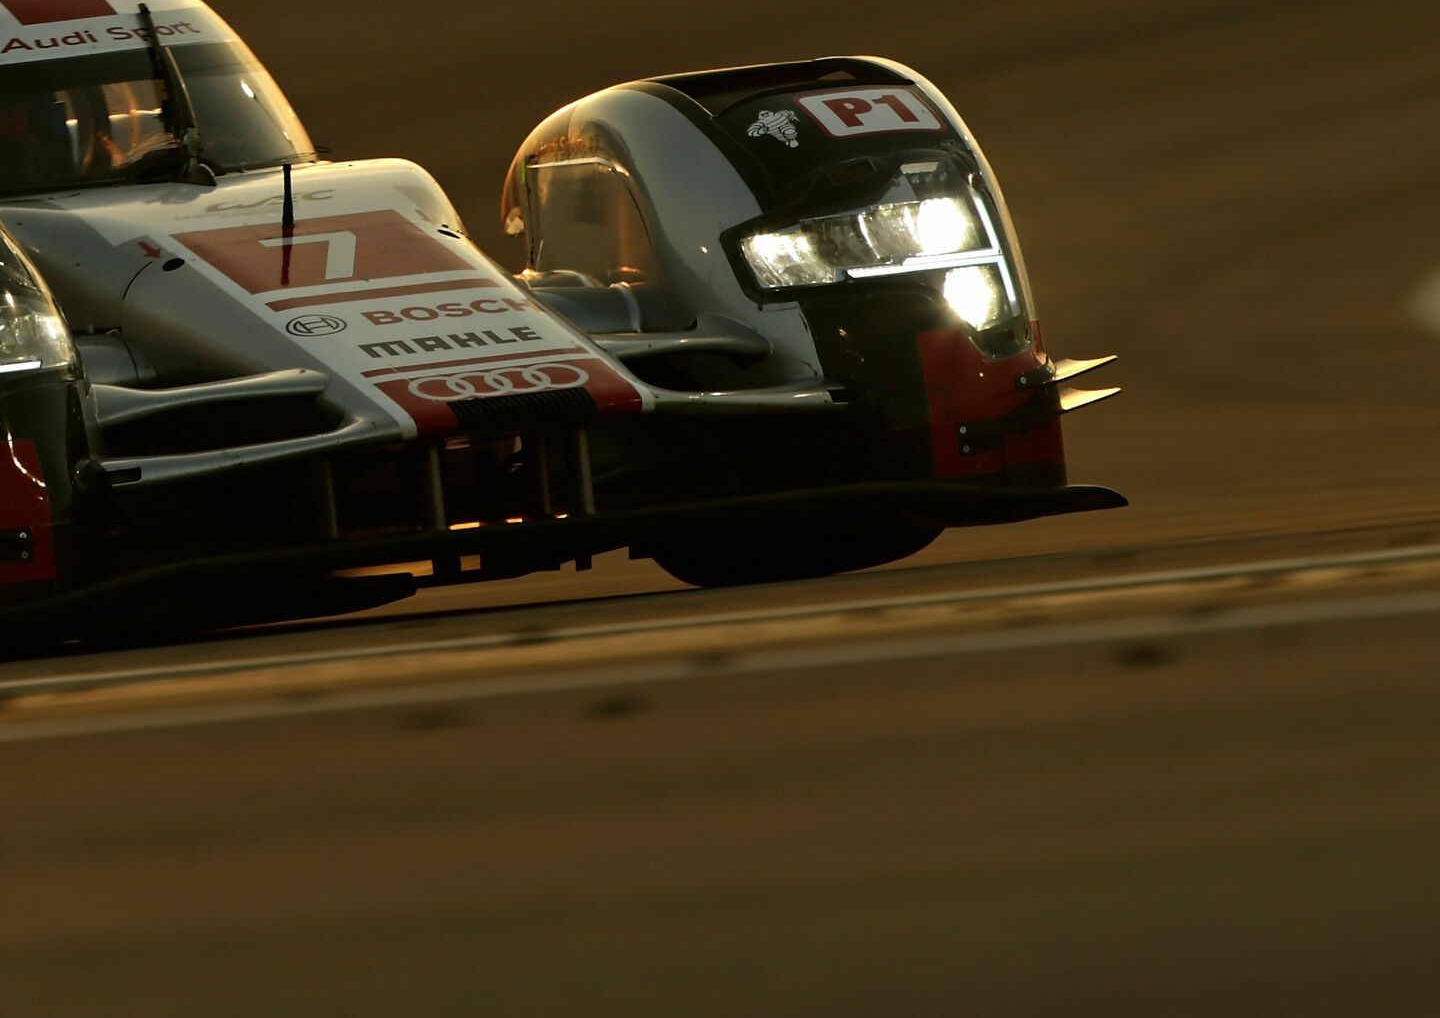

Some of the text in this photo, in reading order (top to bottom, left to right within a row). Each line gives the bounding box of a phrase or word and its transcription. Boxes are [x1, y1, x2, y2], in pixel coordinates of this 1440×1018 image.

[0, 30, 98, 54] Audi
[822, 95, 920, 128] P1
[258, 231, 357, 281] 7
[361, 297, 546, 326] BOSCH
[359, 327, 543, 359] MAHLE
